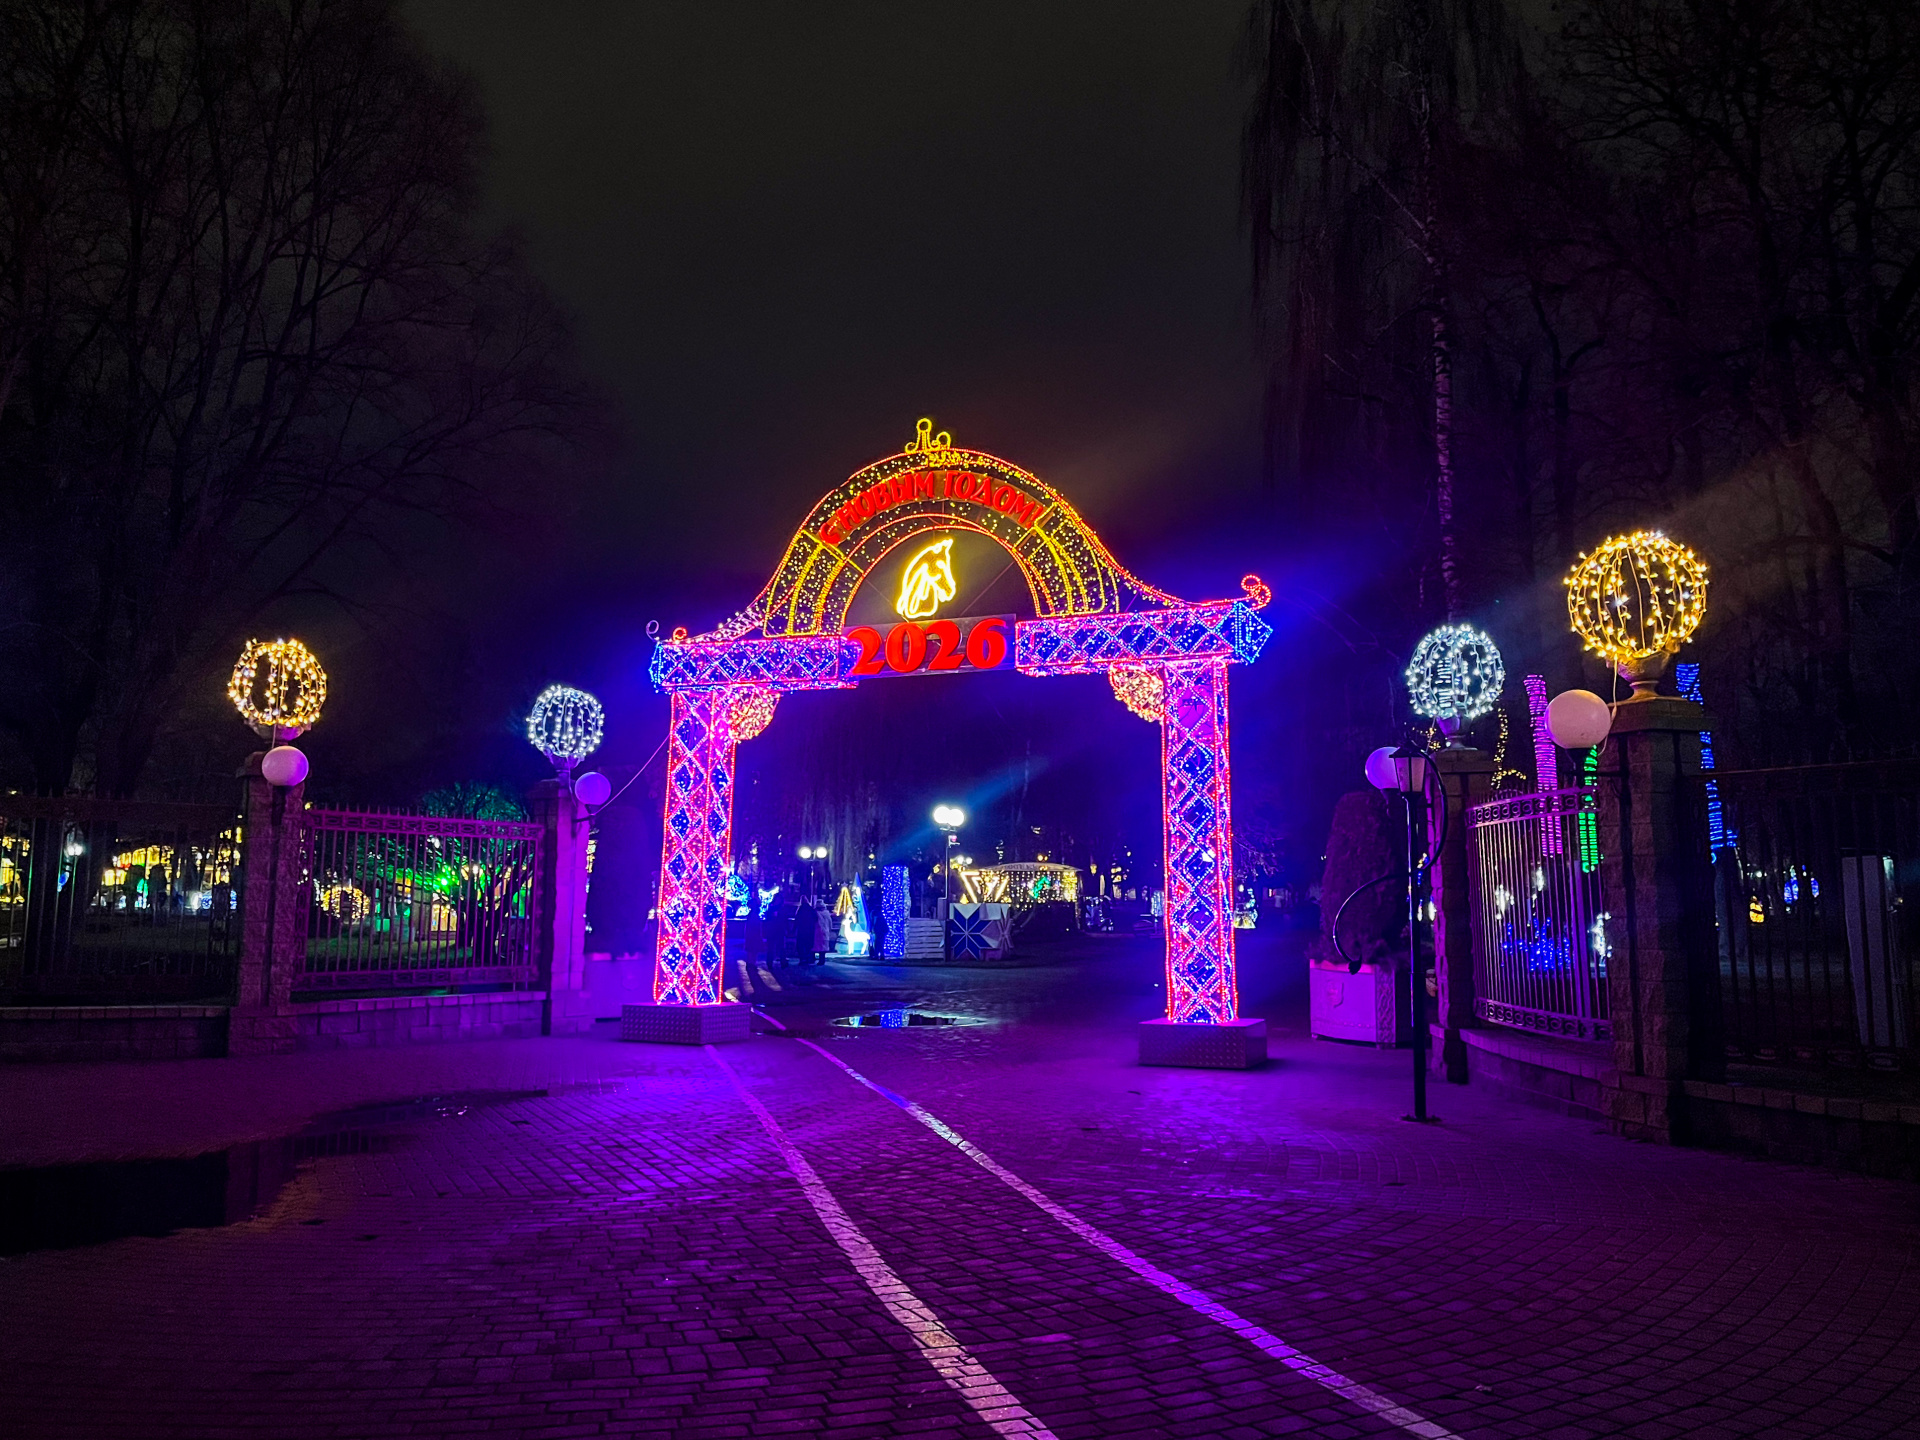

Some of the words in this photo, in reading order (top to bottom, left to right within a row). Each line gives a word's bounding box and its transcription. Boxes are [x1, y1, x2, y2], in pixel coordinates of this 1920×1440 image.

[820, 522, 841, 545] С
[836, 471, 934, 531] НОВЫМ
[943, 470, 1044, 529] ГОДОМ!
[846, 617, 1009, 675] 2026
